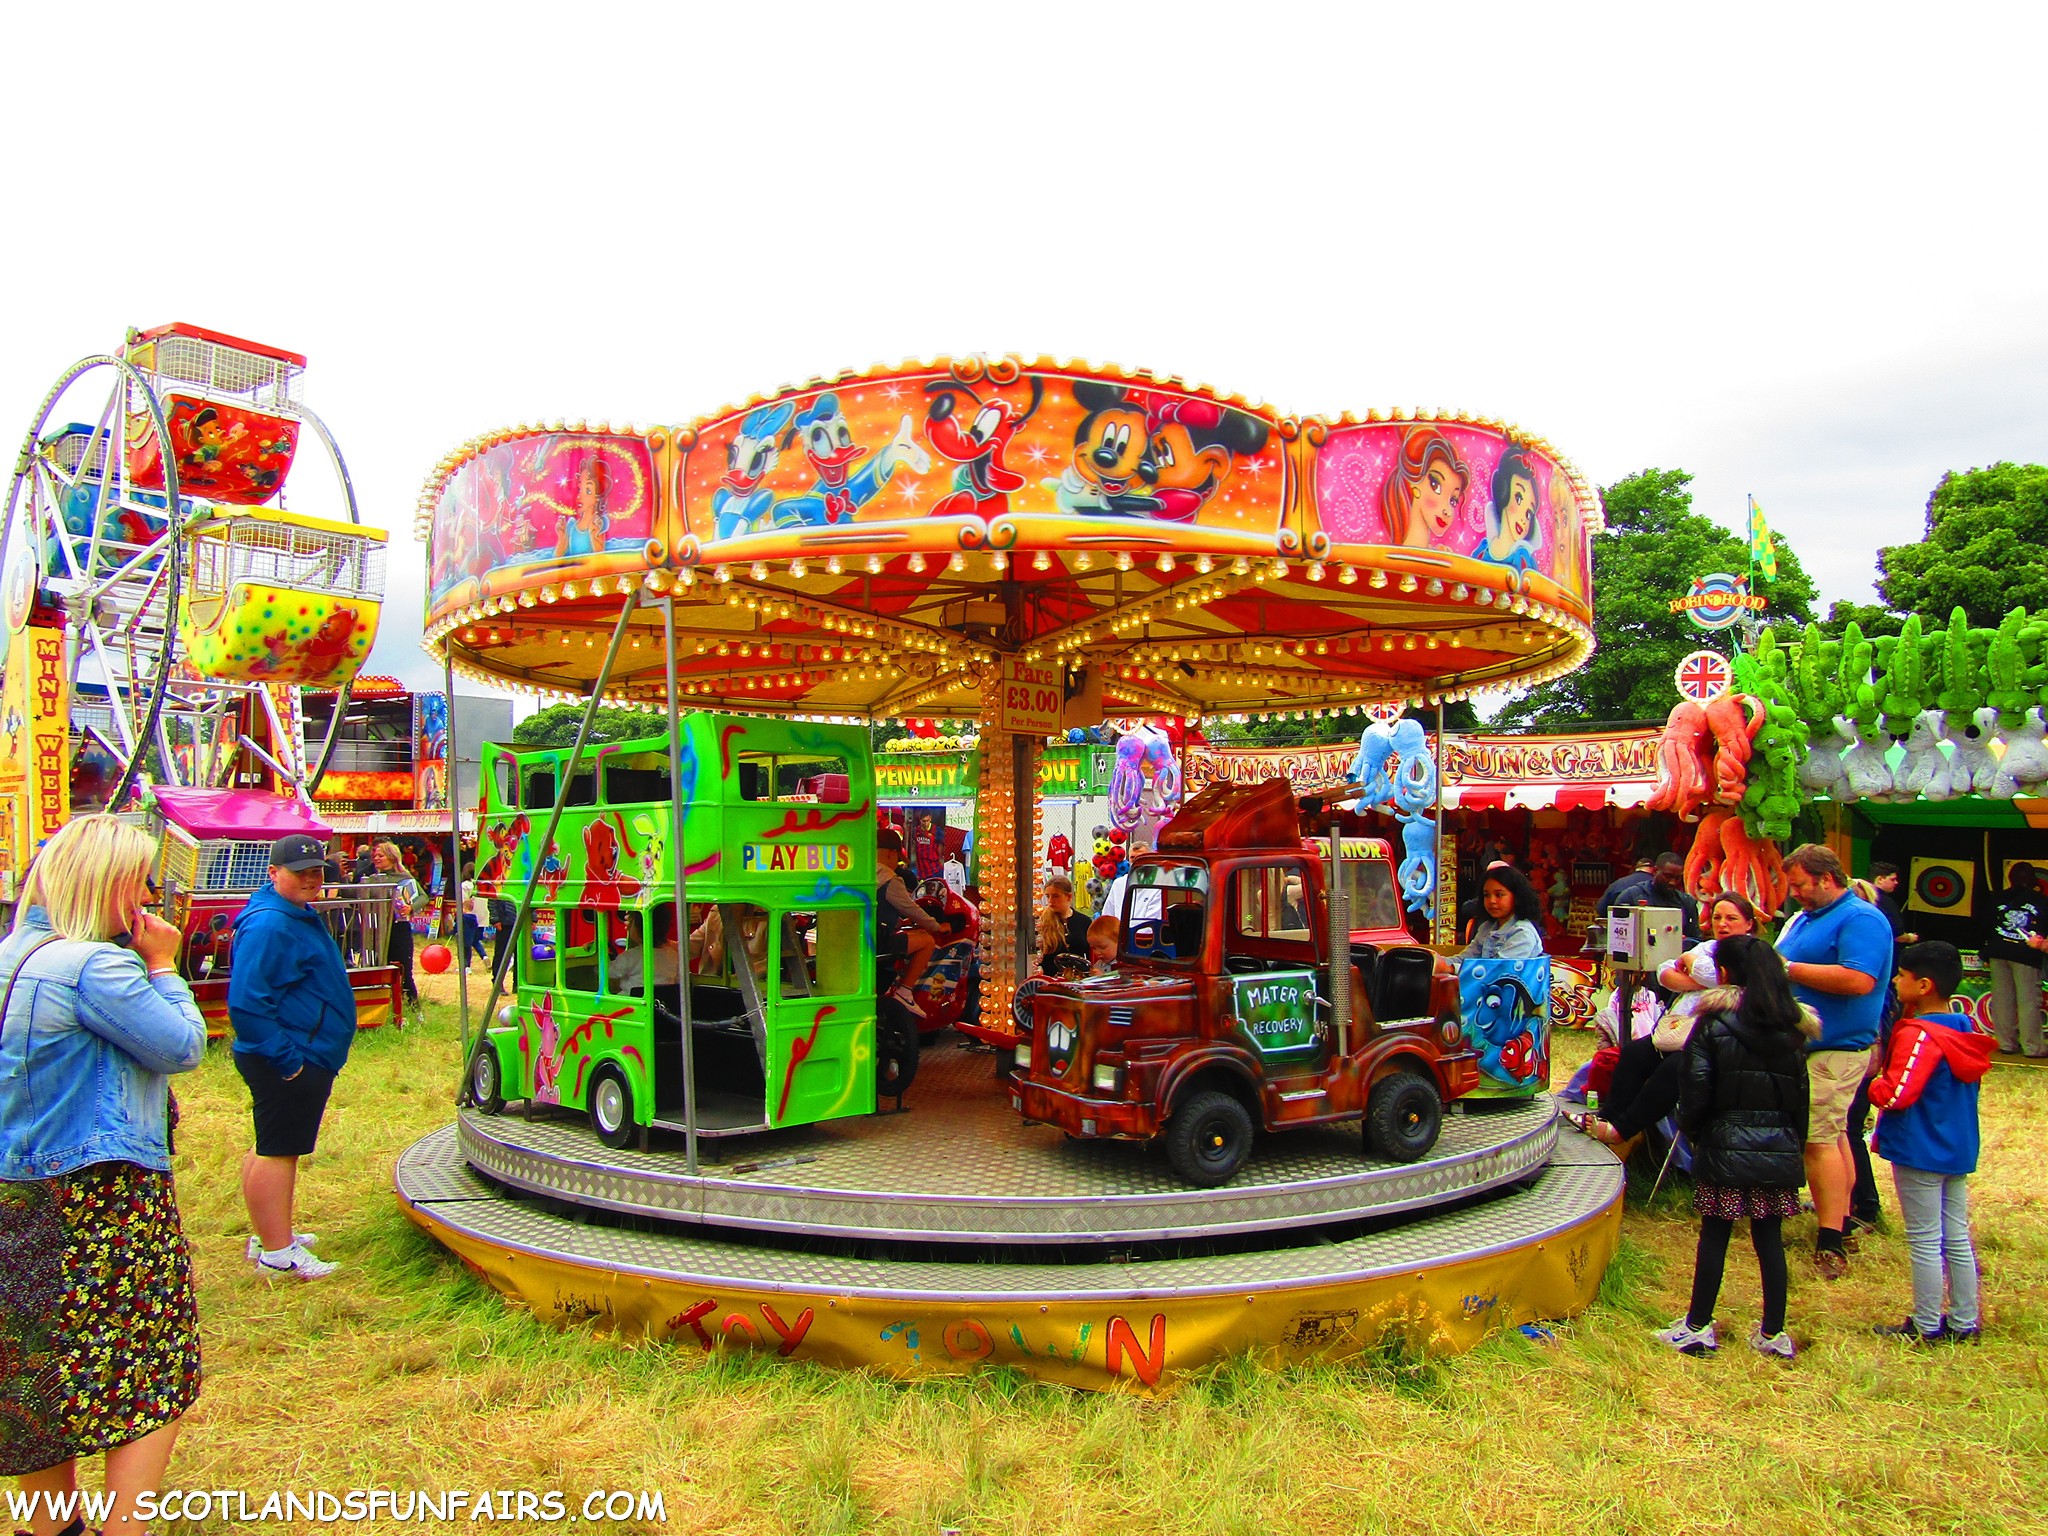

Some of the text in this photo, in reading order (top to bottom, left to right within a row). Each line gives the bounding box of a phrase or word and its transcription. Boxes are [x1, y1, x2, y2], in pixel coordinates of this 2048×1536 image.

[1668, 592, 1767, 614] ROBIN HOOD
[38, 639, 60, 716] MINI
[1013, 661, 1054, 685] Fare
[1006, 686, 1059, 714] £3.00
[1011, 716, 1053, 729] Per Person
[36, 734, 64, 834] WHEEL
[875, 763, 958, 786] PENALTY
[400, 815, 418, 828] AND
[419, 815, 441, 828] SONS
[742, 844, 849, 871] PLAY BUS
[1613, 927, 1628, 937] 461
[1247, 985, 1299, 1008] MATER
[1253, 1017, 1304, 1036] RECOVERY
